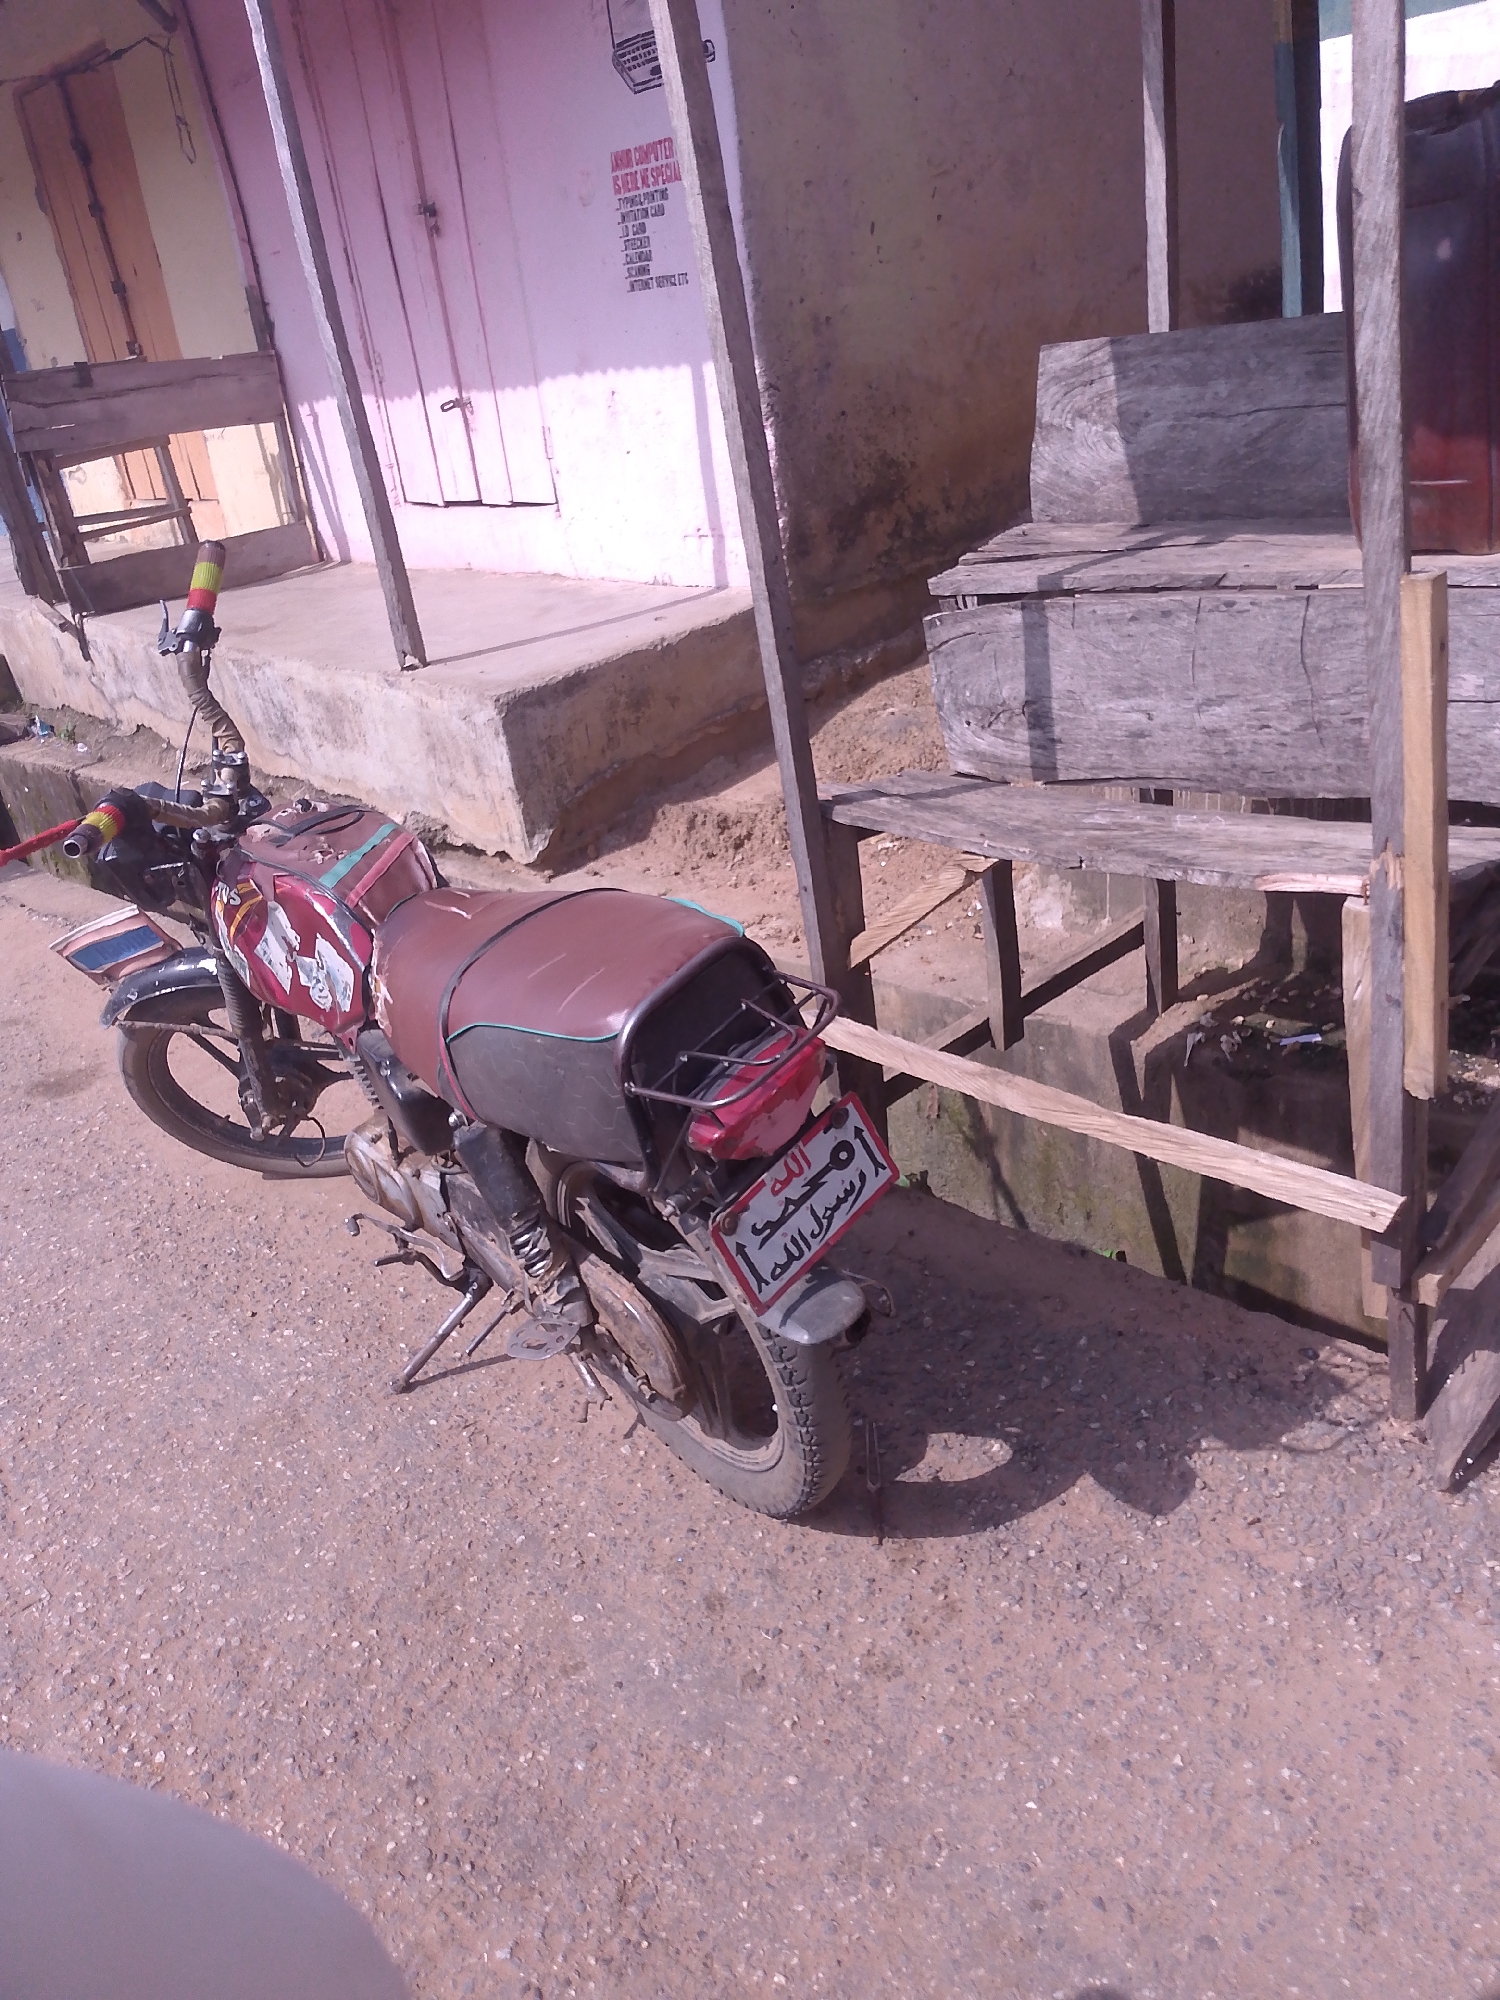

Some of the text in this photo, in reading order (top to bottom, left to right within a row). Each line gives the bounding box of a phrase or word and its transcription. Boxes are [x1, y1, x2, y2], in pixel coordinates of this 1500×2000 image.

[634, 136, 674, 166] COMPUTER
[612, 174, 622, 195] IS
[650, 203, 665, 217] CARD
[632, 222, 646, 236] CARD
[770, 1141, 812, 1197] الله
[751, 1140, 856, 1250] محمد
[770, 1169, 866, 1281] رسول الله
